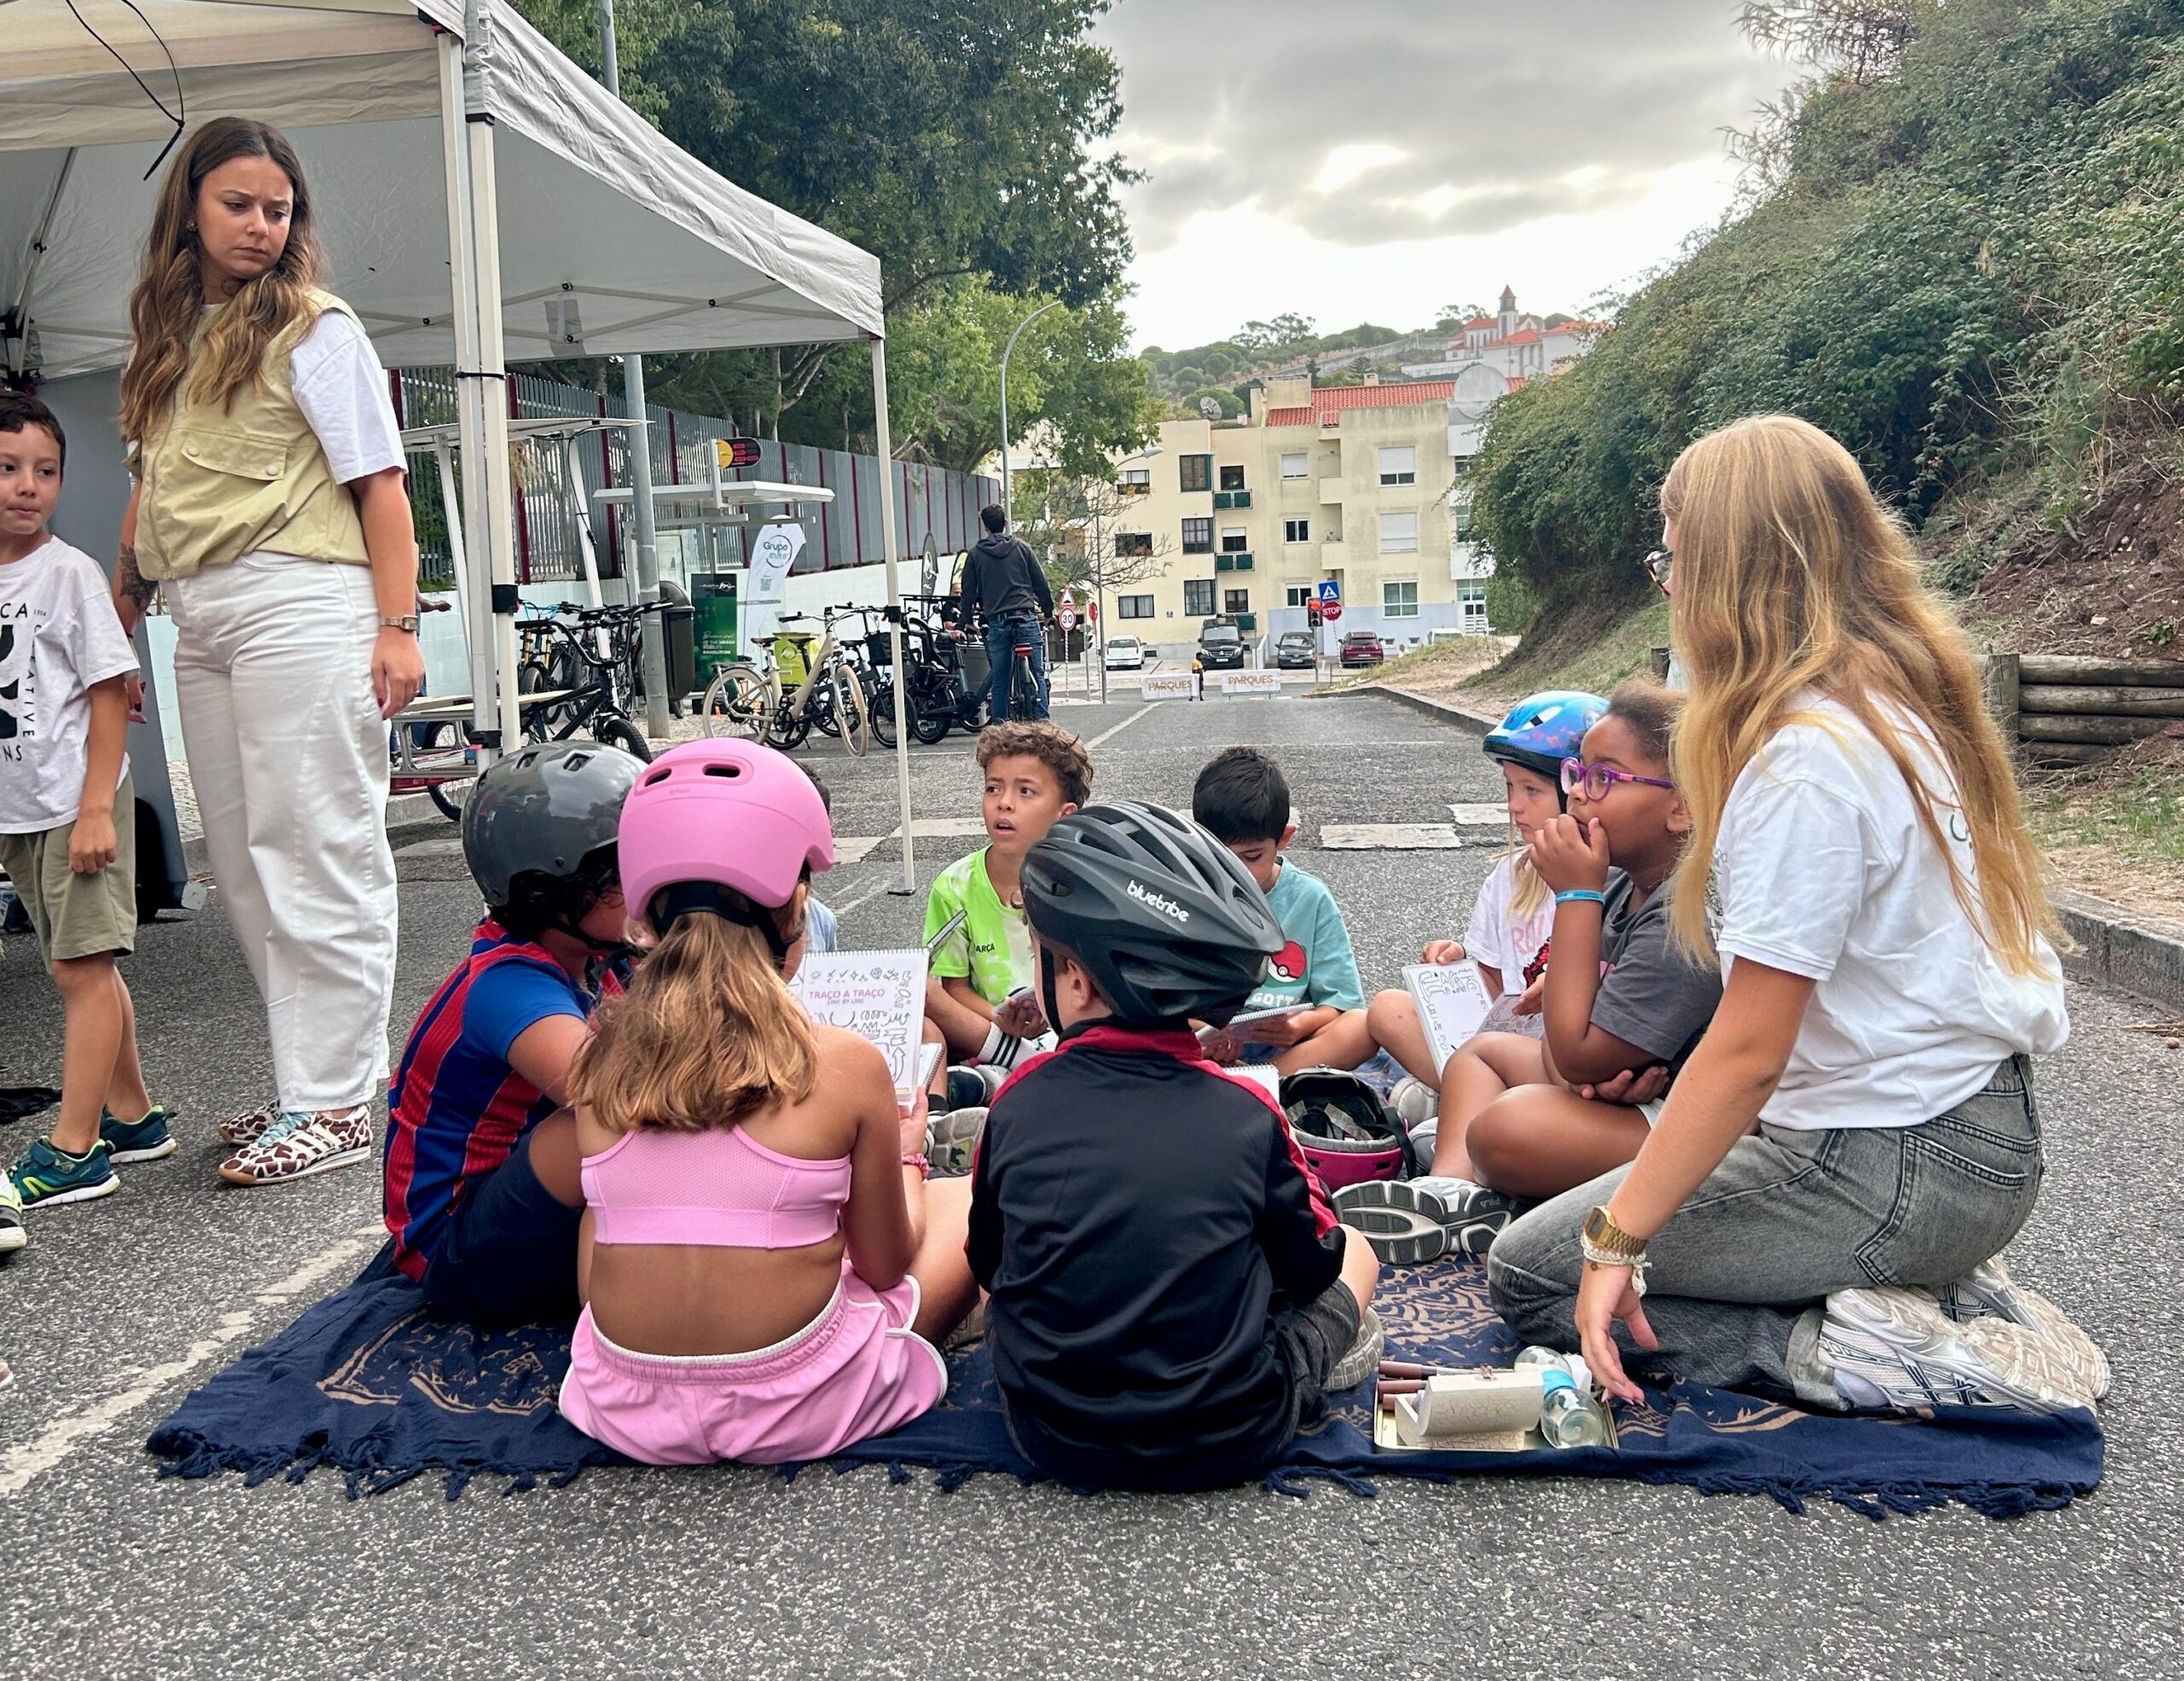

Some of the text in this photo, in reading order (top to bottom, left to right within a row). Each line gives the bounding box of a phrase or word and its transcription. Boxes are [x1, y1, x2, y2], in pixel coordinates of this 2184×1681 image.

[764, 541, 787, 552] Grupo
[1323, 606, 1341, 615] STOP
[1063, 614, 1073, 624] 30
[1228, 675, 1273, 685] PARQUES
[1148, 680, 1192, 691] PARQUES
[1127, 880, 1189, 922] bluetribe
[976, 943, 995, 953] ARÇA
[810, 990, 840, 1001] TRAÇO
[853, 988, 885, 999] TRAÇO
